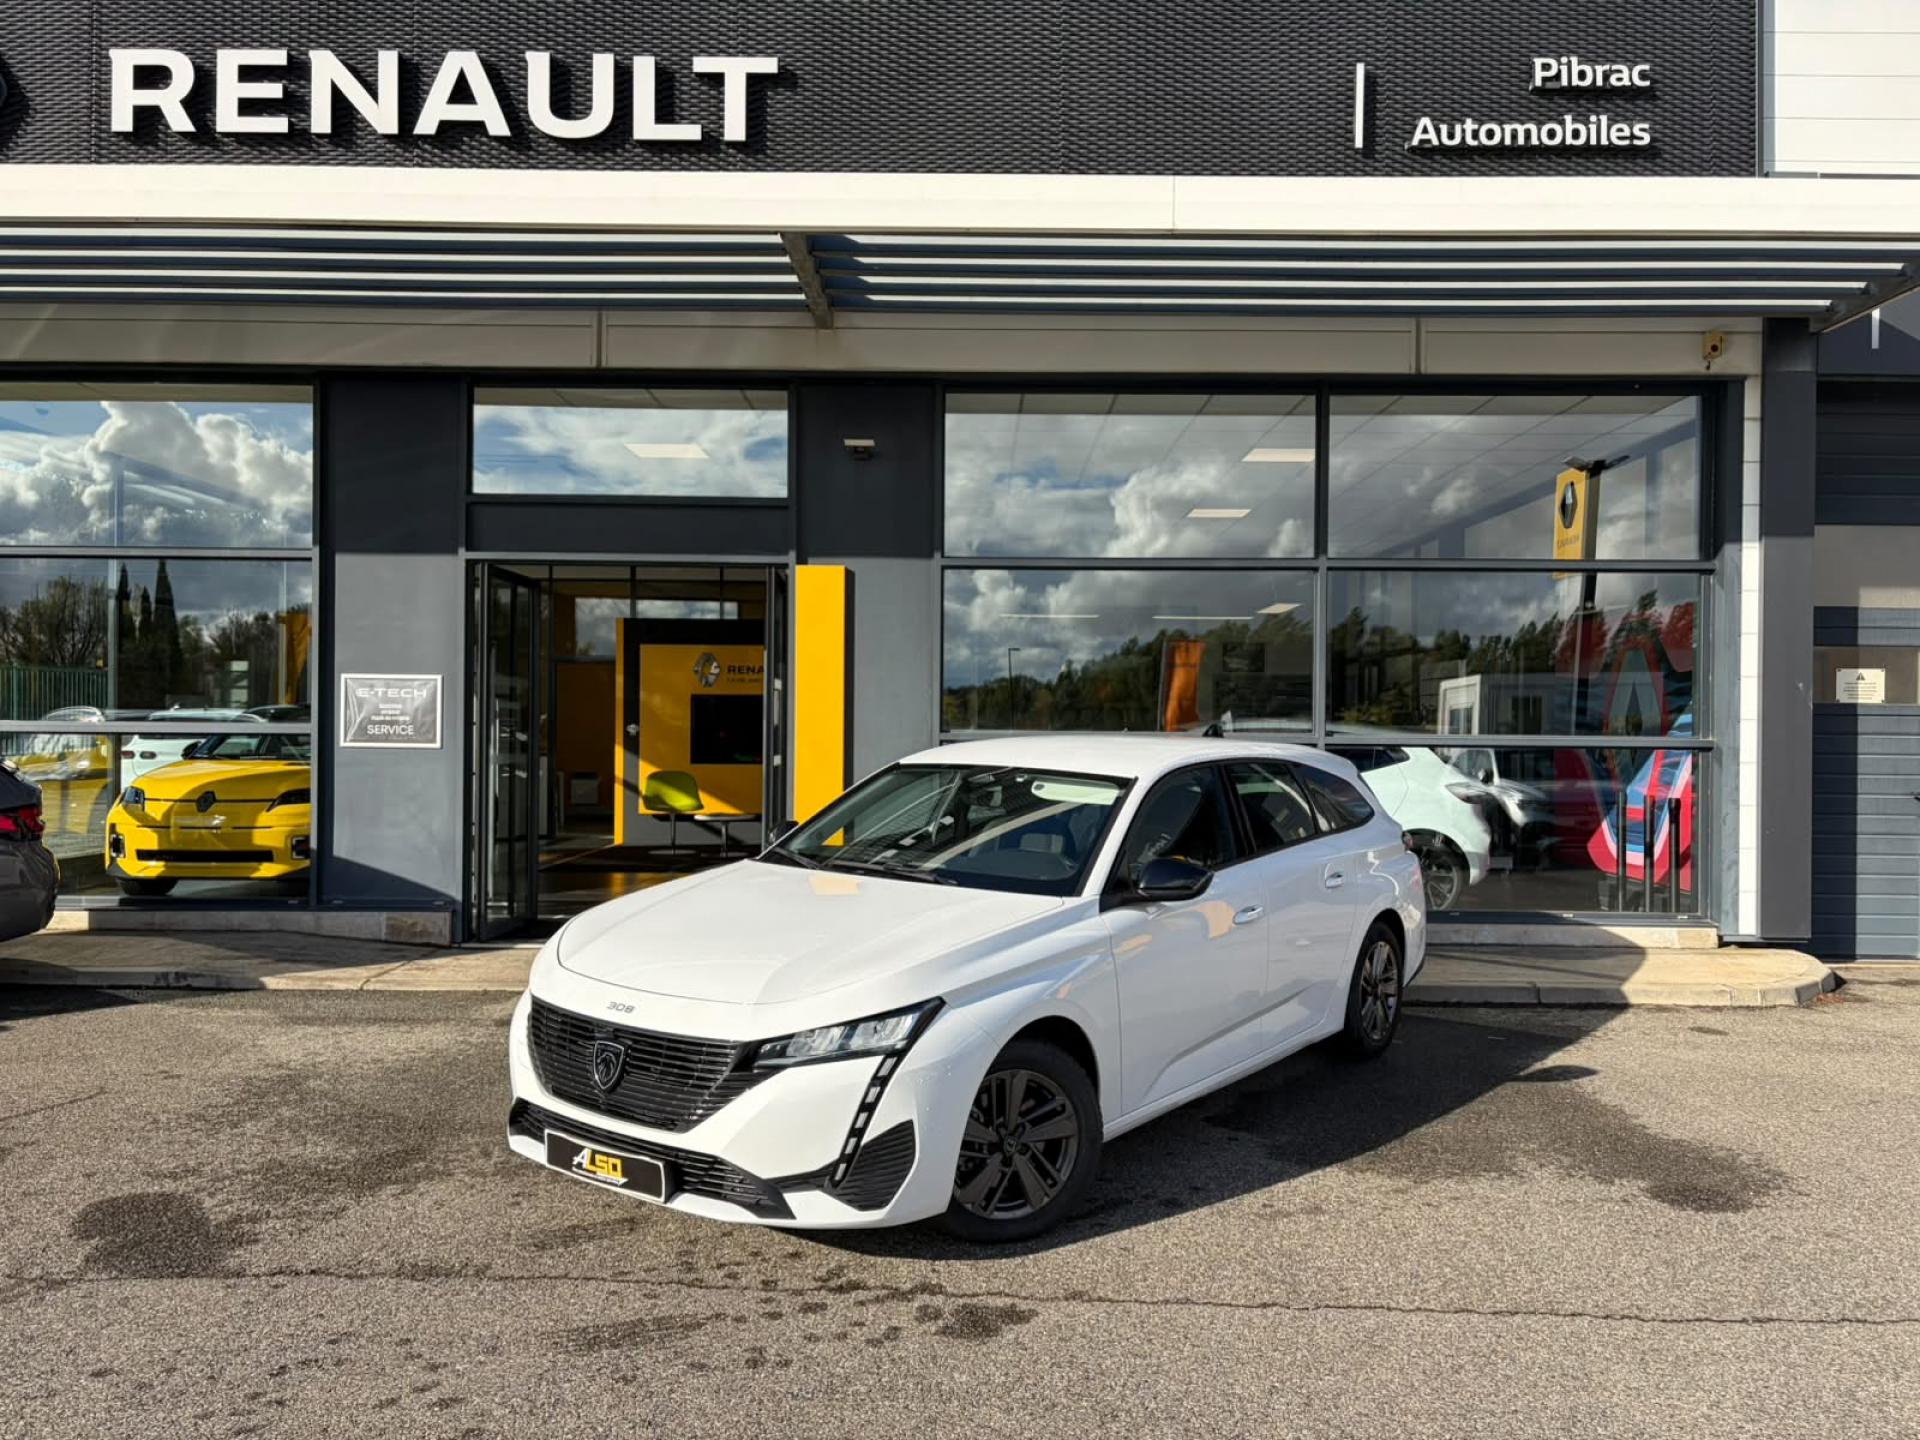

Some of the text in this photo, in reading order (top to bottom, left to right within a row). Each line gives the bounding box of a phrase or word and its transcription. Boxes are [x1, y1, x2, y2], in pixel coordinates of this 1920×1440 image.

[1533, 56, 1650, 87] Pibrac
[109, 49, 778, 142] RENAULT
[1411, 115, 1651, 146] Automobiles
[367, 725, 414, 735] SERVICE
[606, 1001, 636, 1014] 308
[572, 1148, 623, 1181] ALSO
